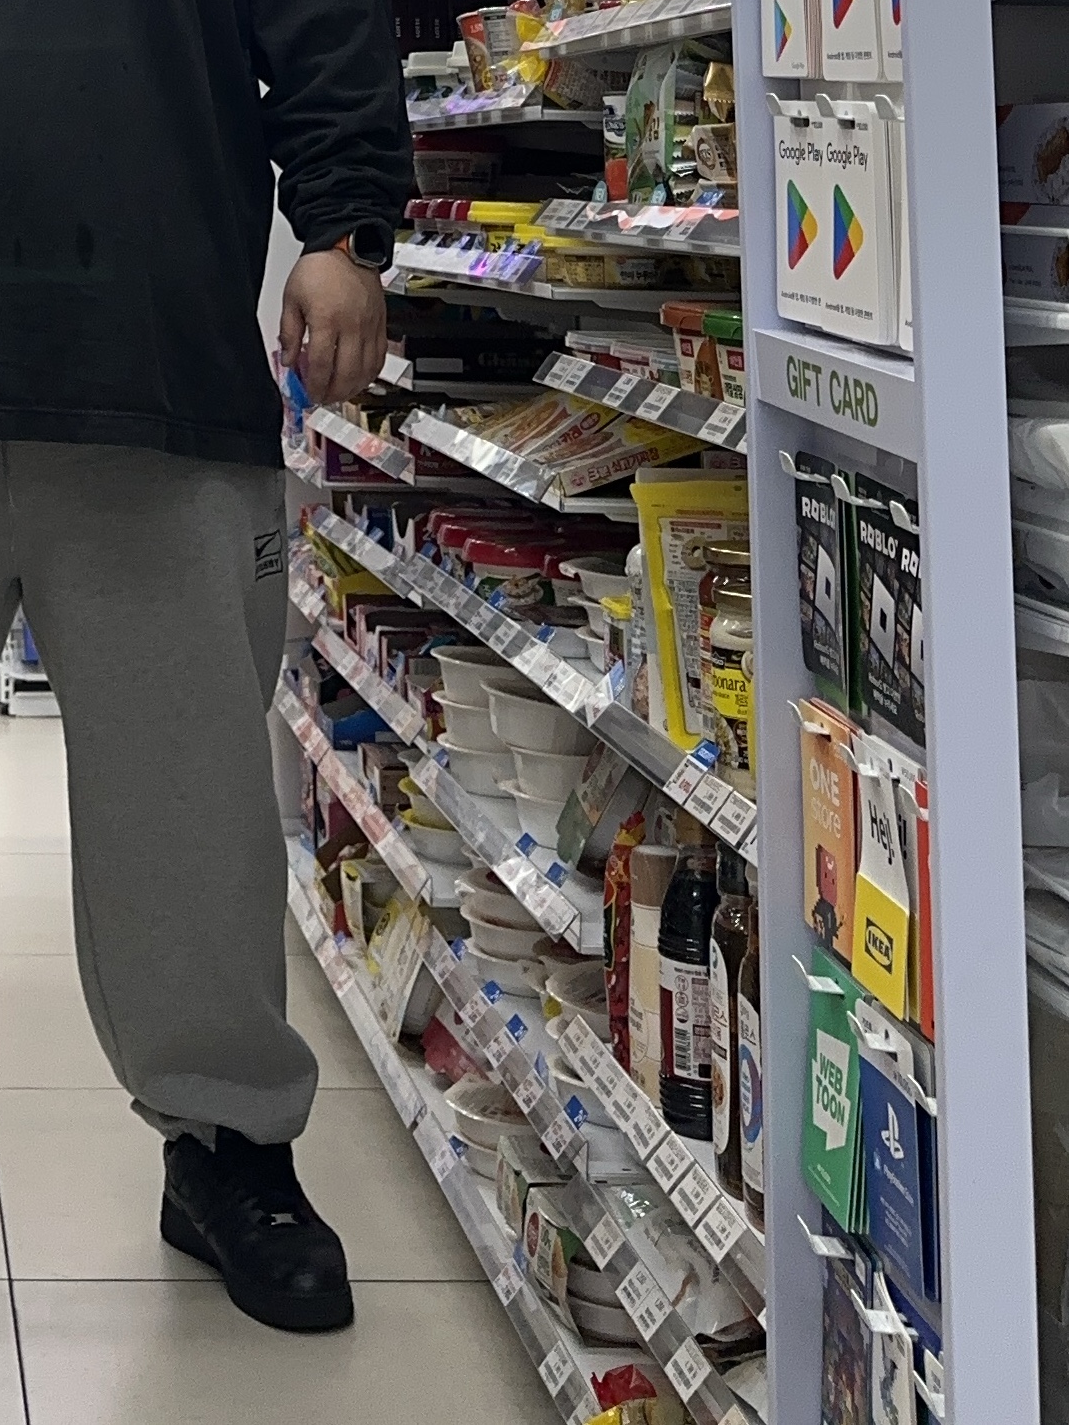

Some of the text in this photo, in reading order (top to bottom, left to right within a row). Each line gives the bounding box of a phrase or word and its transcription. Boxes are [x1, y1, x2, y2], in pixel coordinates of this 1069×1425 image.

[779, 140, 823, 167] Google Play
[826, 141, 869, 172] Google Play
[786, 354, 879, 429] GIFT CARD
[801, 496, 836, 531] ROBLO
[860, 519, 899, 560] ROBLO
[809, 757, 840, 807] ONE
[867, 929, 893, 963] IKEA
[819, 1052, 843, 1097] WEB
[815, 1073, 846, 1128] TOON
